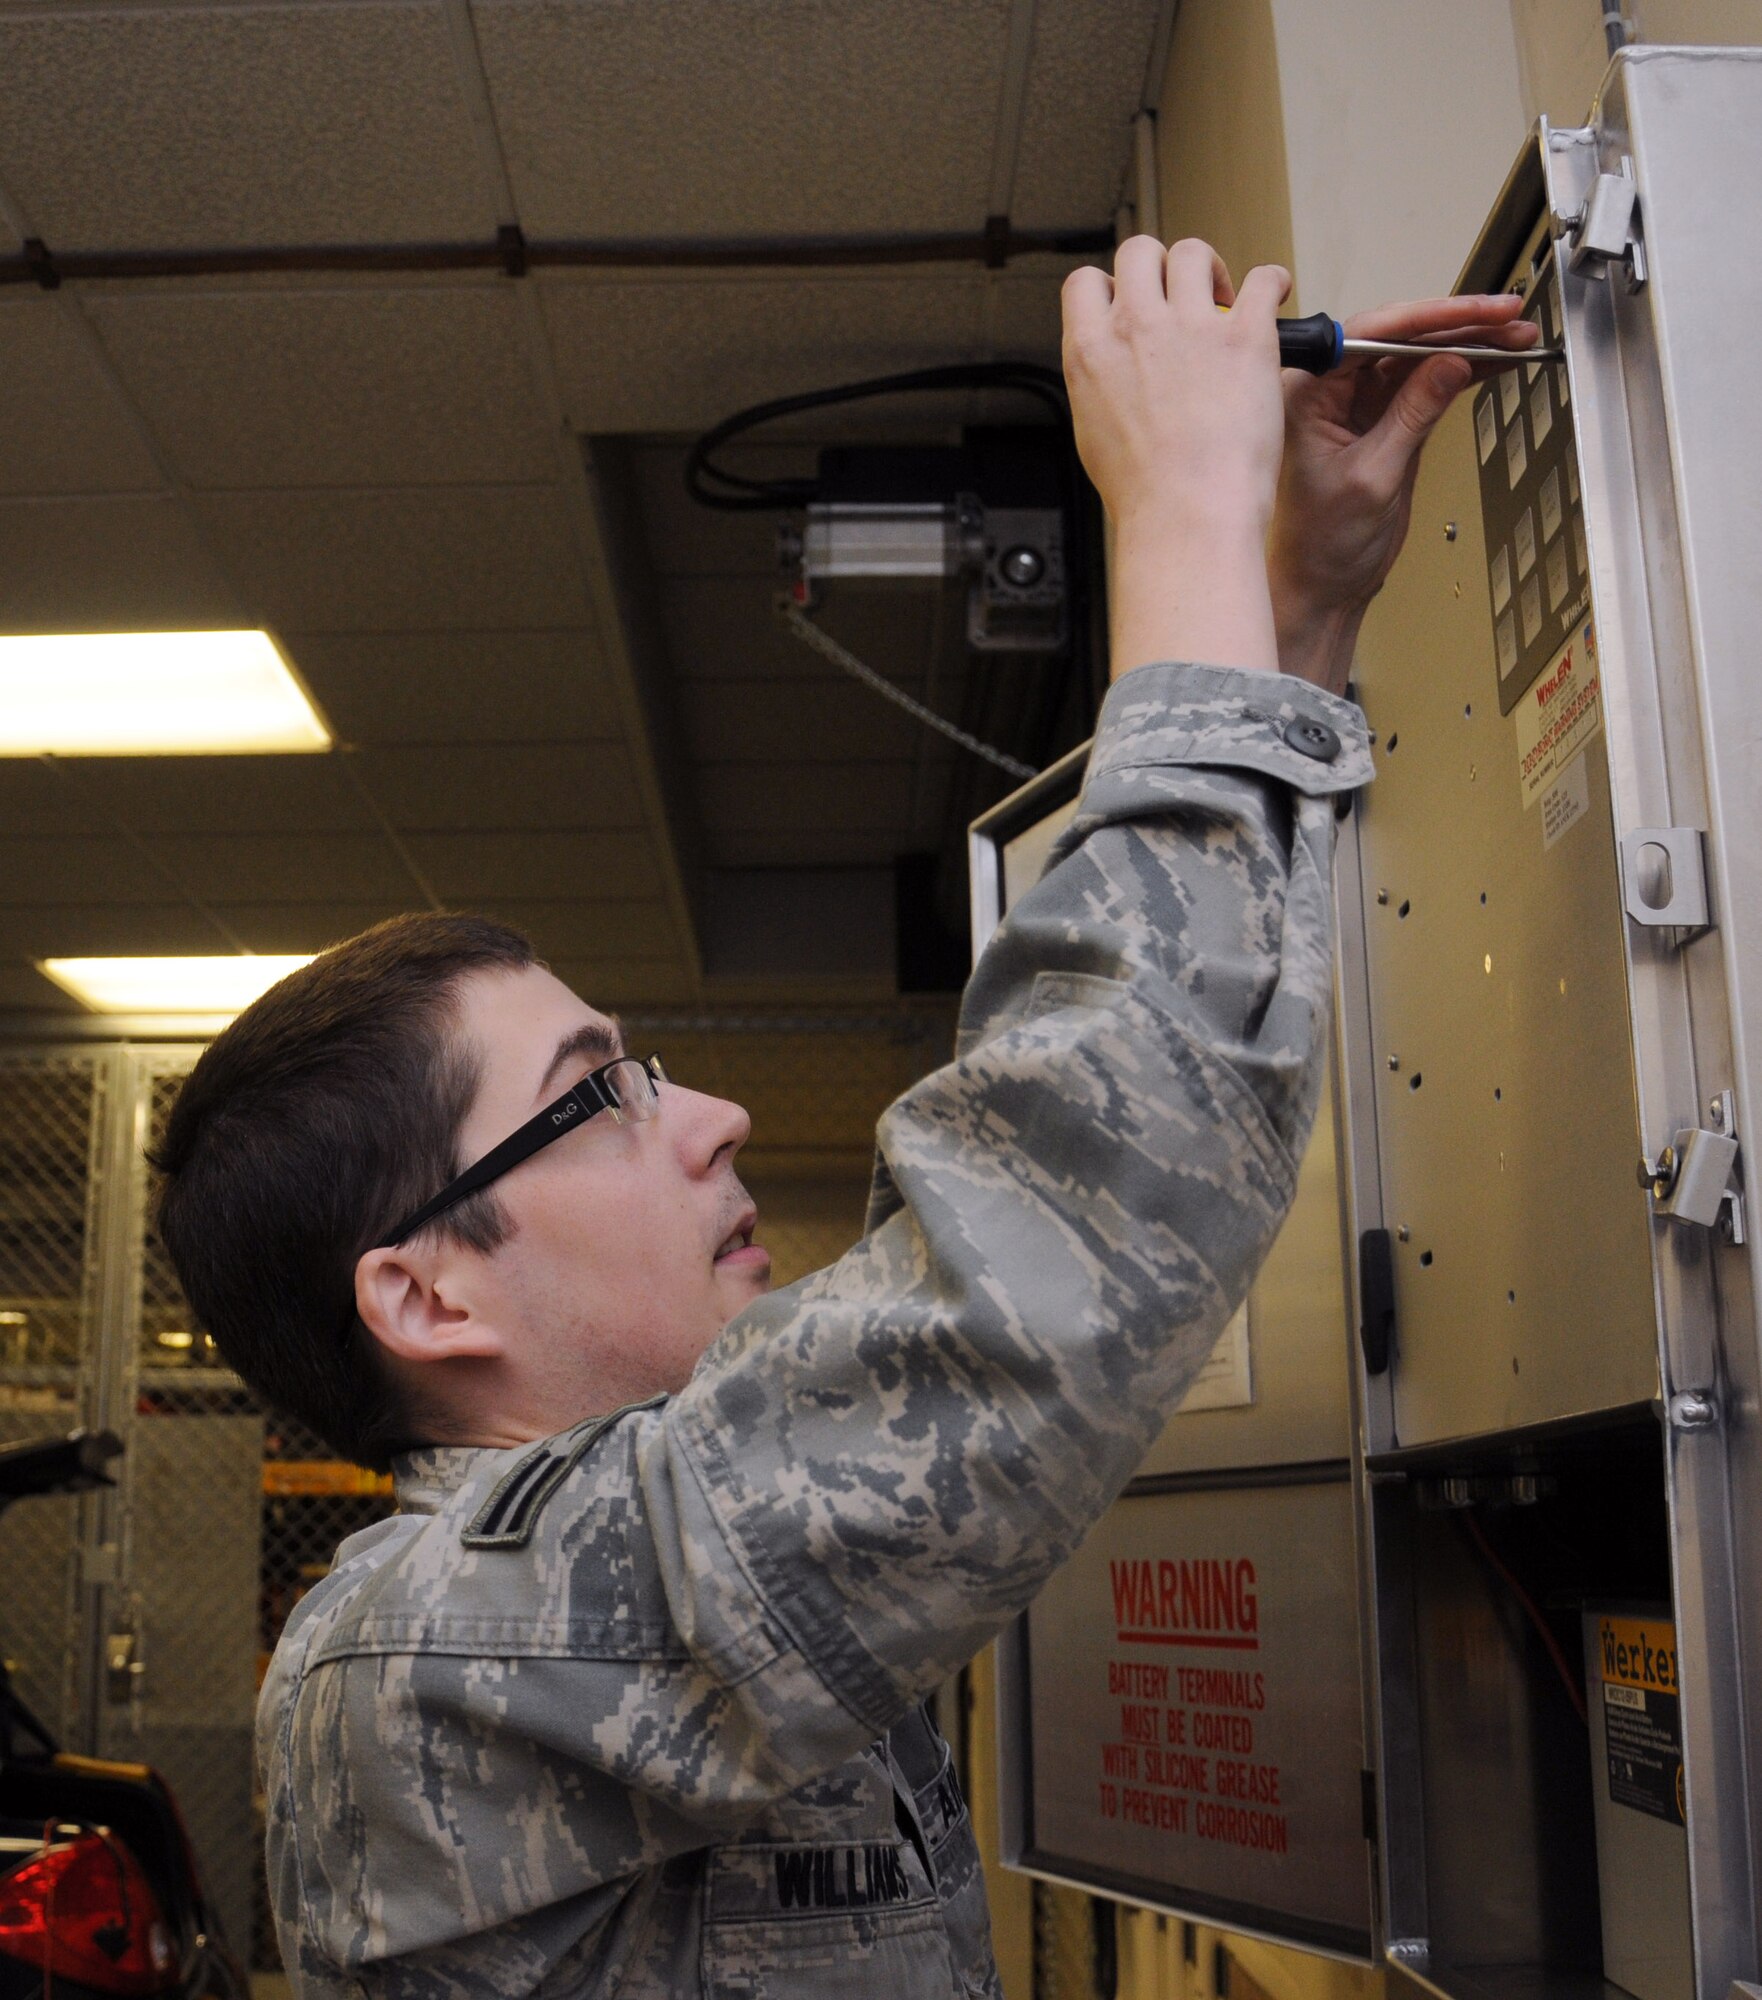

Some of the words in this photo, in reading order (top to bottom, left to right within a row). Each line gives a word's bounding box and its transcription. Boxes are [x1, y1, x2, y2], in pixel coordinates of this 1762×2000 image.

[1536, 647, 1572, 707] WHELEN
[551, 1102, 578, 1126] D&G
[1110, 1558, 1258, 1633] WARNING
[1108, 1660, 1169, 1699] BATTERY
[1177, 1667, 1265, 1711] TERMINALS
[1121, 1703, 1160, 1742] MUST
[1167, 1708, 1186, 1746] BE
[1194, 1711, 1252, 1755] COATED
[1102, 1743, 1138, 1780] WITH
[1145, 1749, 1209, 1794] SILICONE
[1216, 1760, 1281, 1806] GREASE
[1099, 1783, 1117, 1819] TO
[1122, 1788, 1189, 1834] PREVENT
[1196, 1801, 1287, 1854] CORROSION
